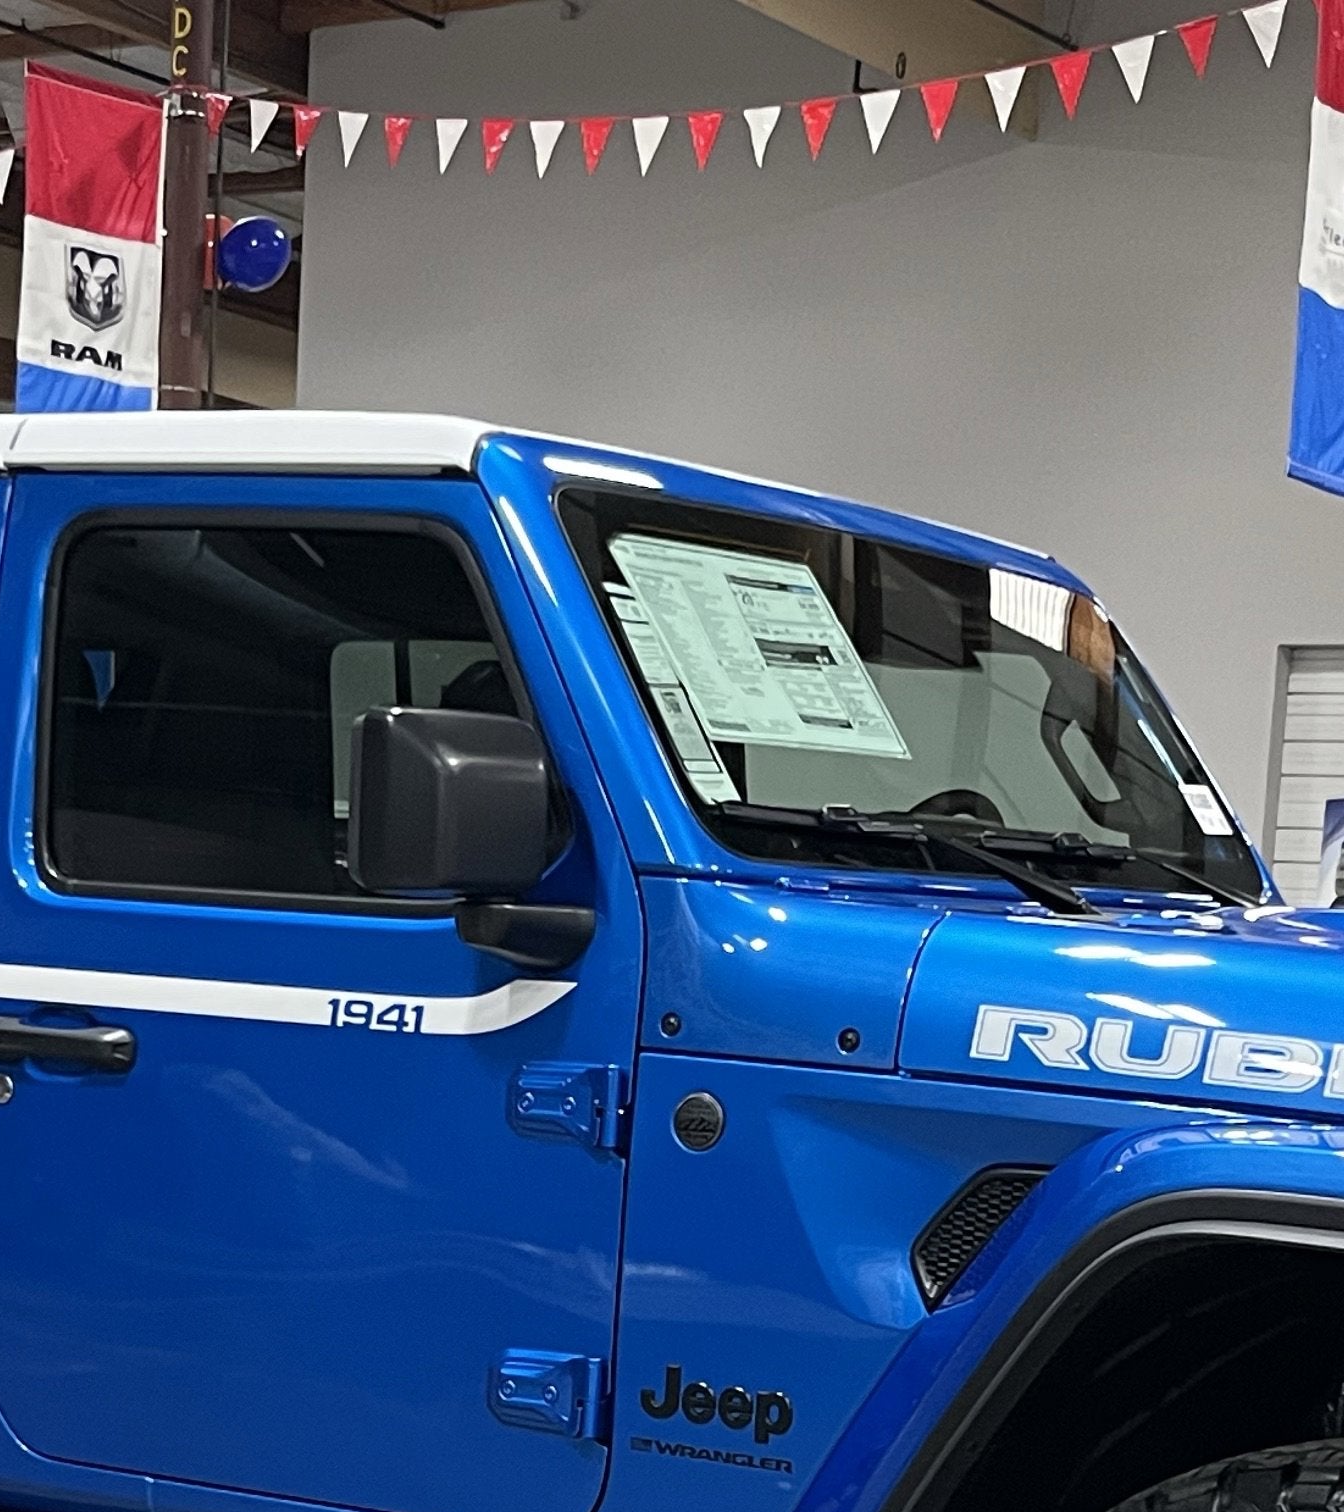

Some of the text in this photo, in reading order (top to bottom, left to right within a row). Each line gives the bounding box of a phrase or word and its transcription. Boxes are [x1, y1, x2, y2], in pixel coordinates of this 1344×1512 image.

[50, 338, 123, 372] RAM
[327, 998, 425, 1034] 1941
[639, 1363, 794, 1444] Jeep
[654, 1439, 794, 1474] WRANGLER
